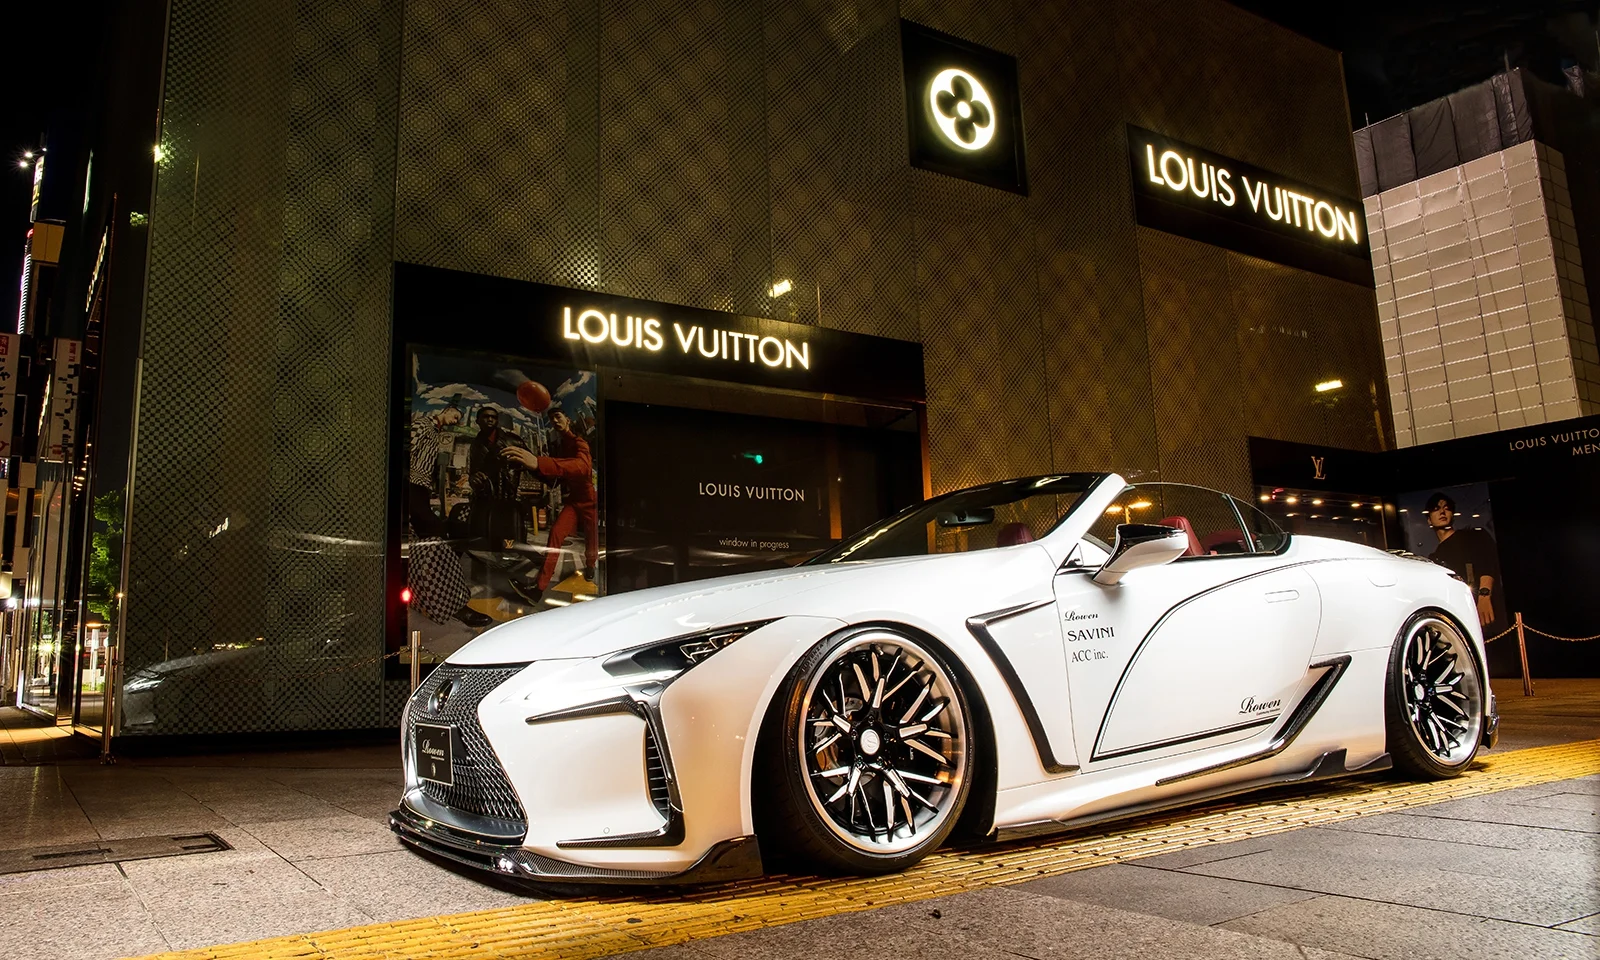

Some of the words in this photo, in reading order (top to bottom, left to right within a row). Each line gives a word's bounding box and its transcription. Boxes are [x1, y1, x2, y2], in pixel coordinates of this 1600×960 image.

[1146, 144, 1236, 207] LOUIS
[1241, 175, 1359, 245] VUITTON
[563, 307, 664, 351] LOUIS
[673, 323, 810, 370] VUITTON
[1509, 436, 1547, 451] LOUIS
[699, 482, 741, 498] LOUIS
[745, 485, 805, 502] VUITTON
[719, 537, 749, 547] window
[750, 539, 758, 548] in
[759, 540, 790, 551] progress
[1064, 610, 1099, 621] Rowen
[1067, 627, 1115, 642] SAVINI
[1071, 649, 1092, 663] ACC
[1093, 649, 1109, 660] inc.
[1238, 695, 1281, 714] Rowen
[422, 739, 444, 756] Rowen
